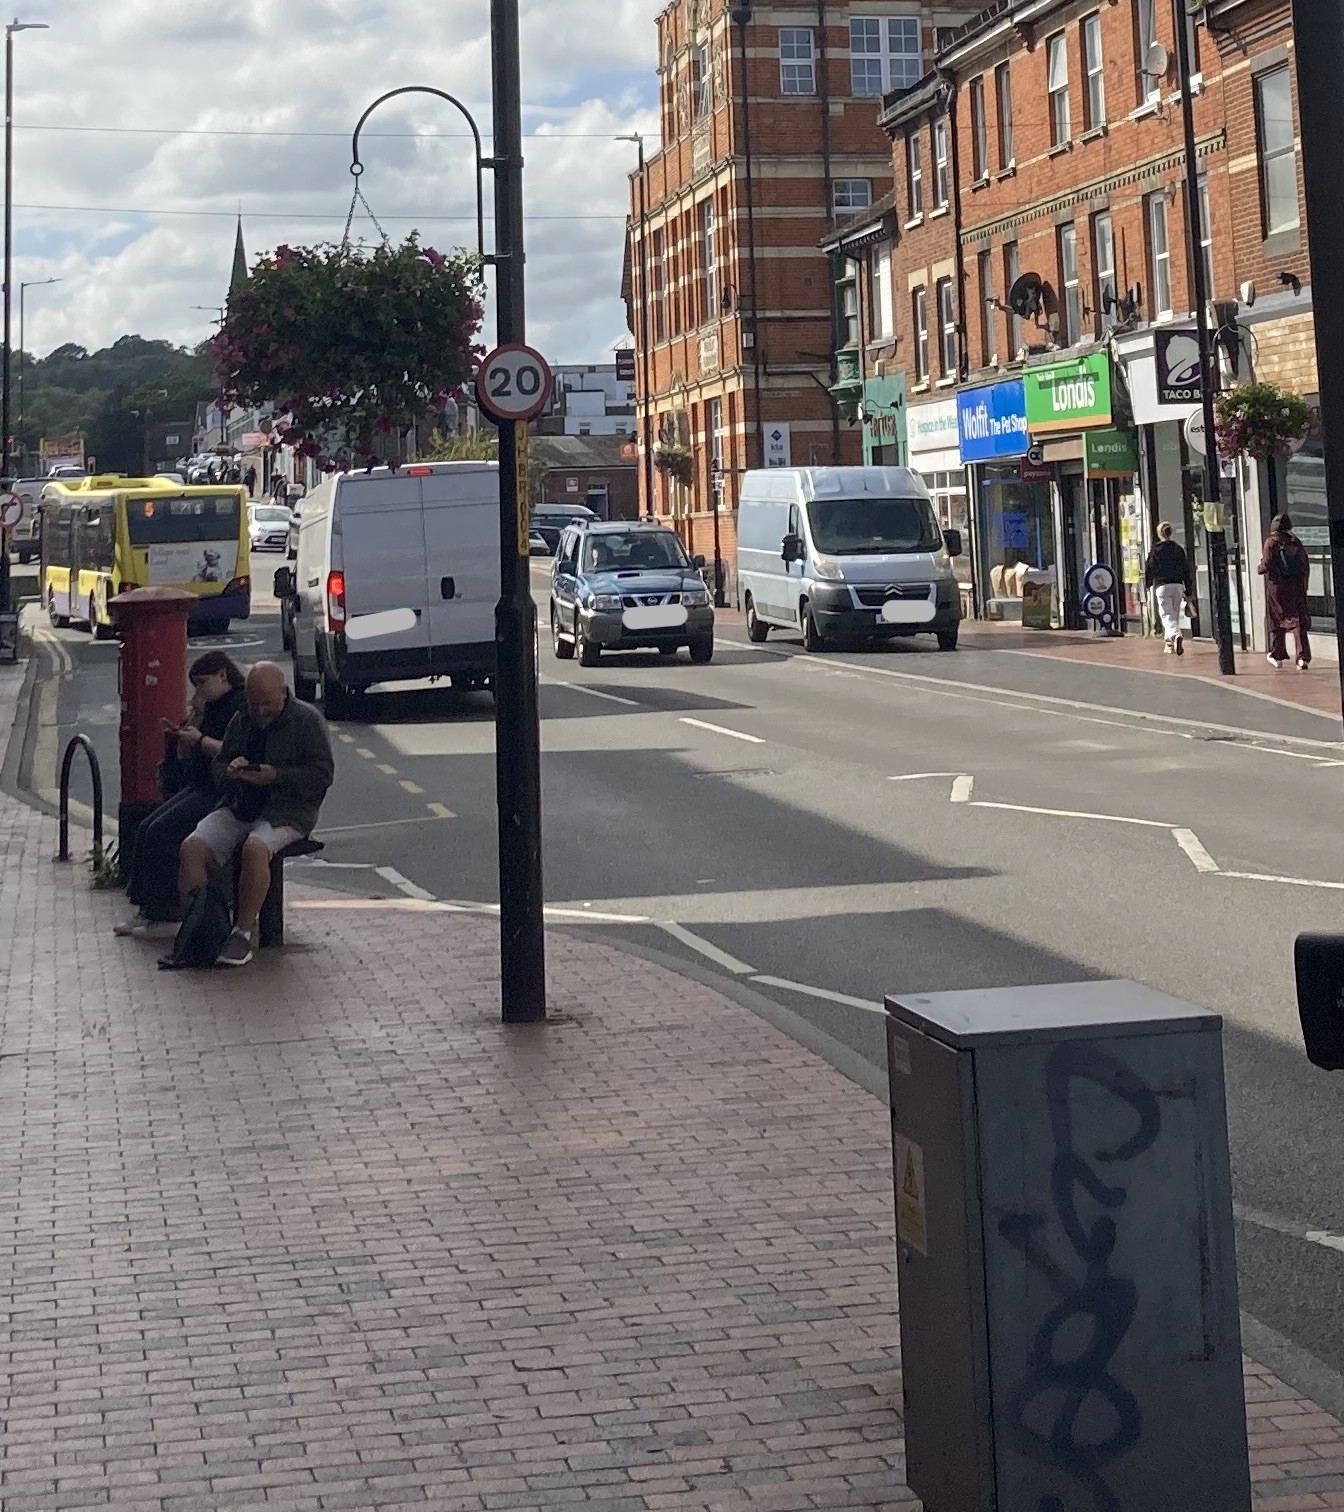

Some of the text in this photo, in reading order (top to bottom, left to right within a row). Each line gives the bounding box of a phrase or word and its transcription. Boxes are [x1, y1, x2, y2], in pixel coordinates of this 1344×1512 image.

[489, 365, 540, 397] 20
[1051, 366, 1096, 411] Londis
[1163, 389, 1191, 400] TACO
[1091, 442, 1128, 453] Londis
